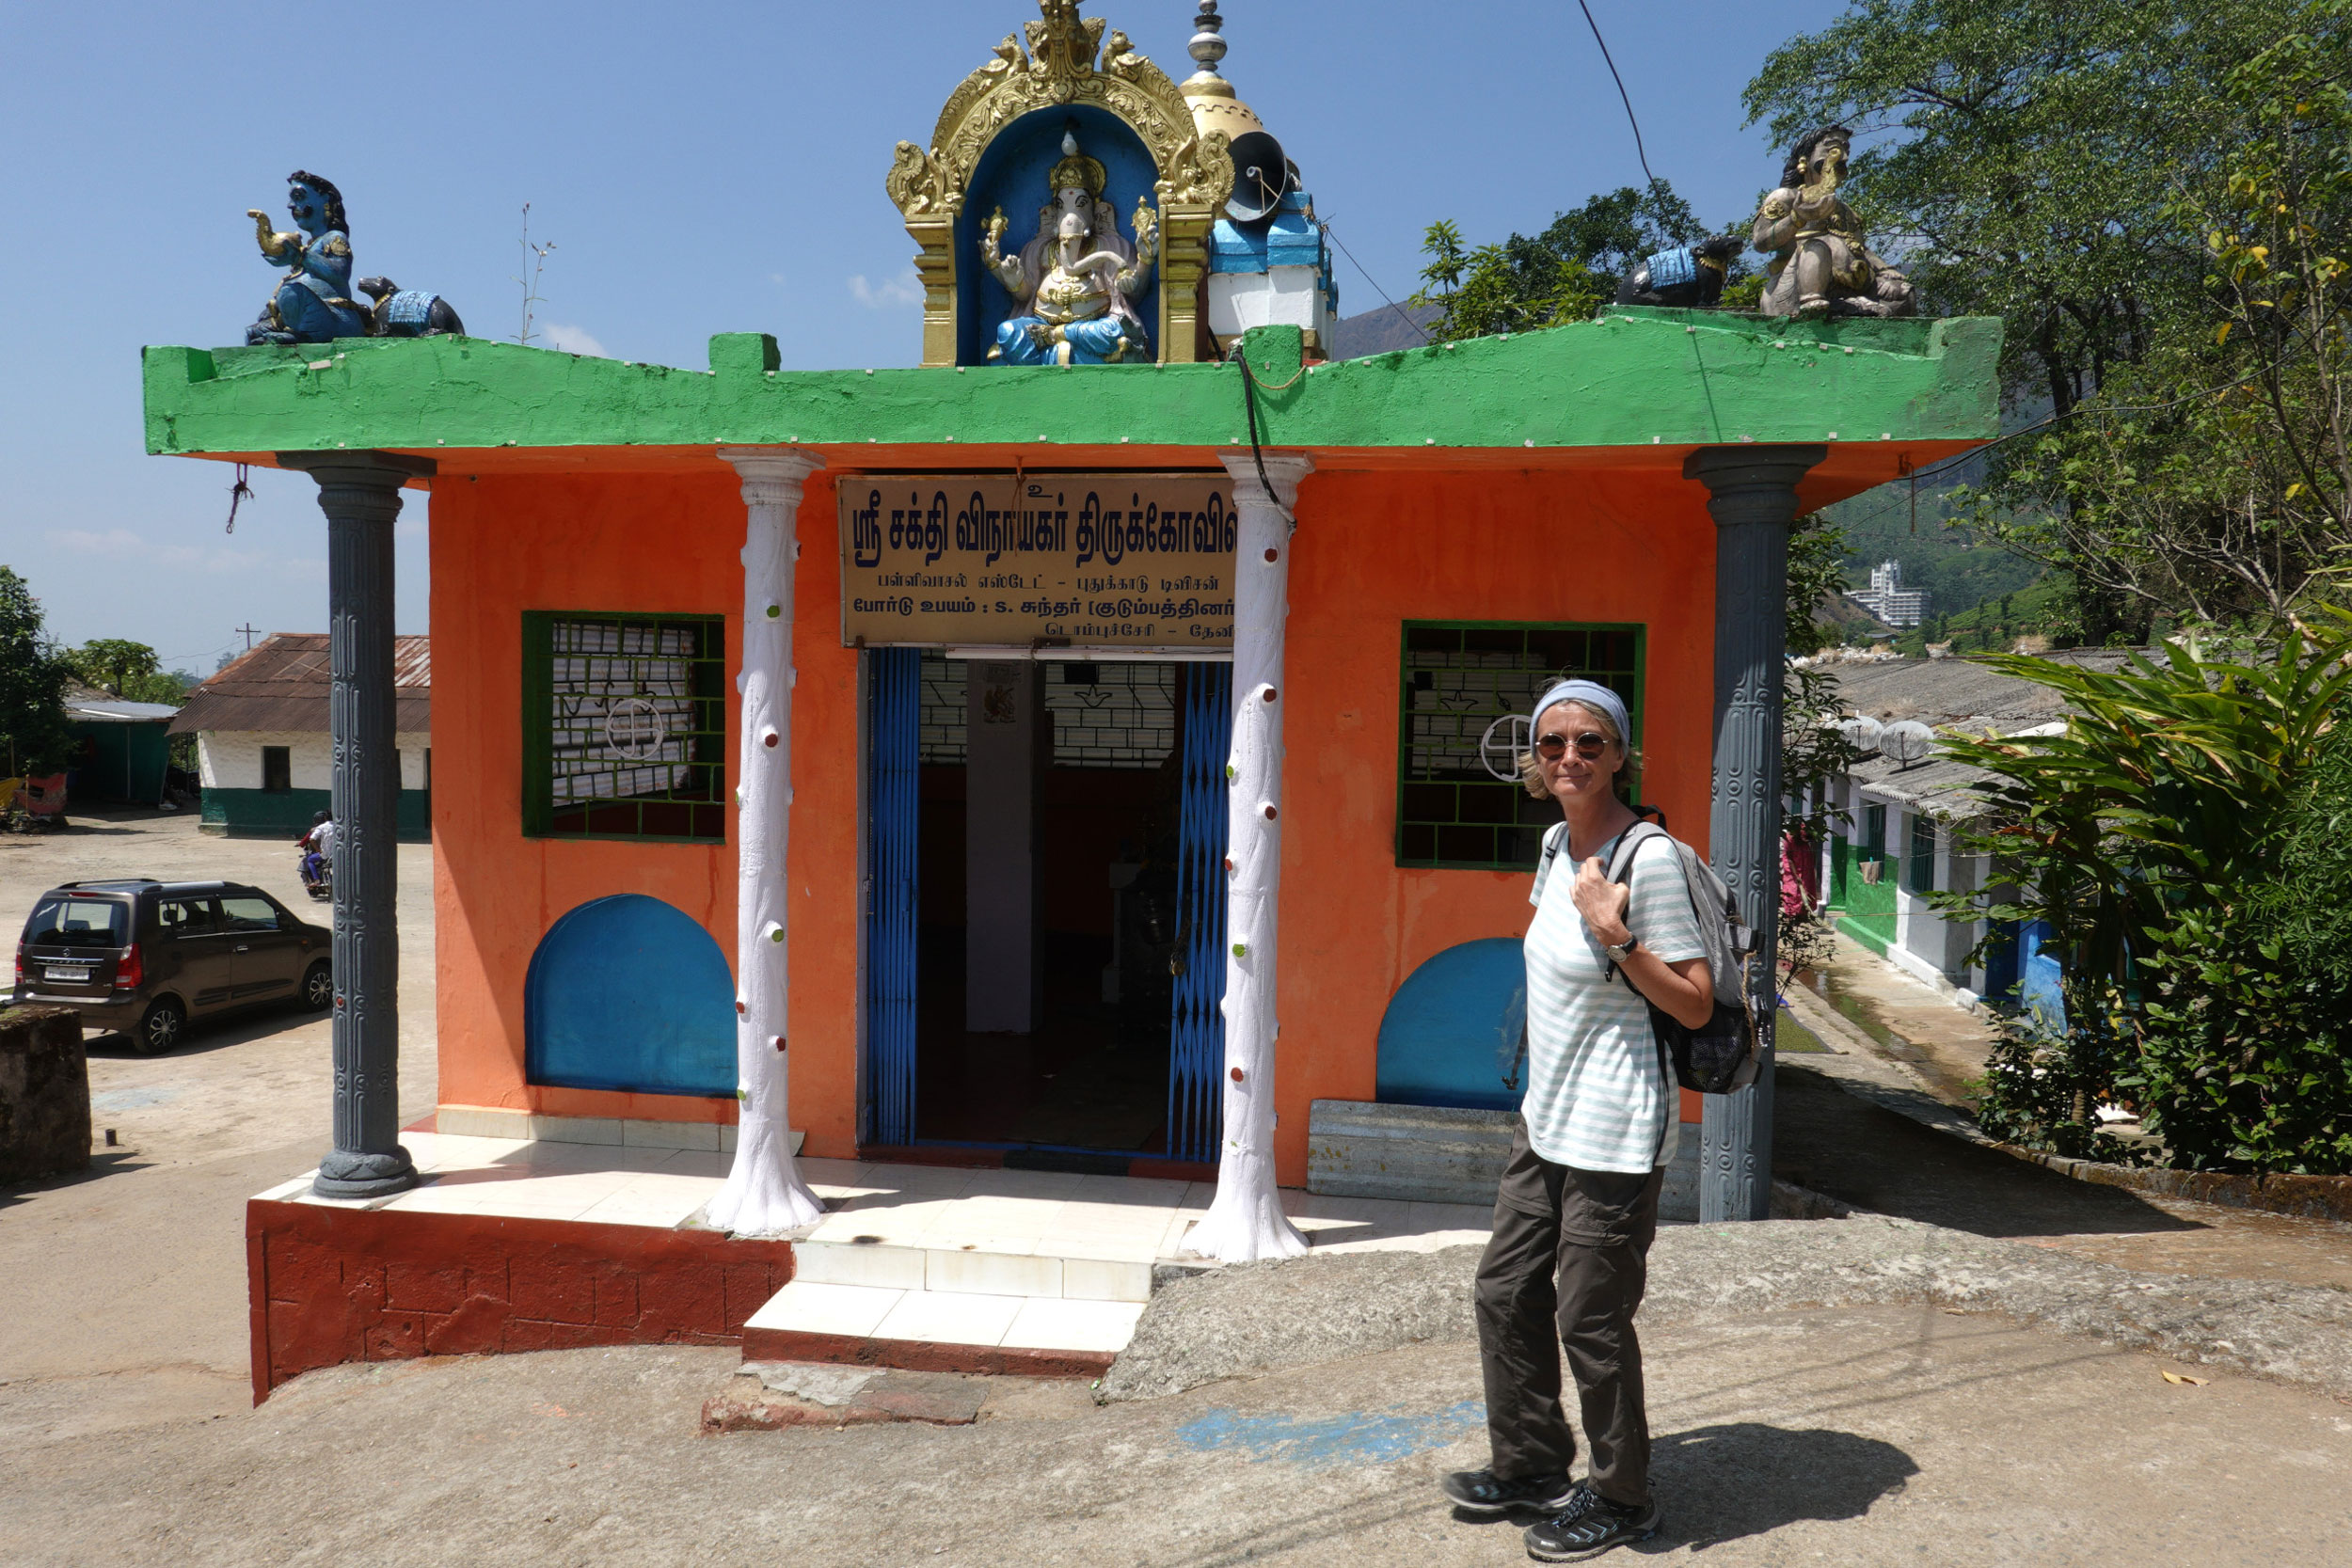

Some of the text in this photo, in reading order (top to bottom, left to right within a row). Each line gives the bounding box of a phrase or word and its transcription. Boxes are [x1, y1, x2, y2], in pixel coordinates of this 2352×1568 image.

[889, 490, 948, 567] சக்தி
[956, 490, 1069, 567] விநாயகர்
[877, 572, 967, 588] பள்ளிவாசல்
[977, 573, 1047, 590] எஸ்டேட்
[1077, 575, 1149, 594] புதுக்காடு
[1160, 575, 1219, 593] டிவிசன்
[853, 595, 914, 616] போர்டு
[919, 596, 976, 613] உபயம்
[1020, 596, 1081, 618] சுந்தர்
[1045, 622, 1155, 639] டொம்புச்சேரி
